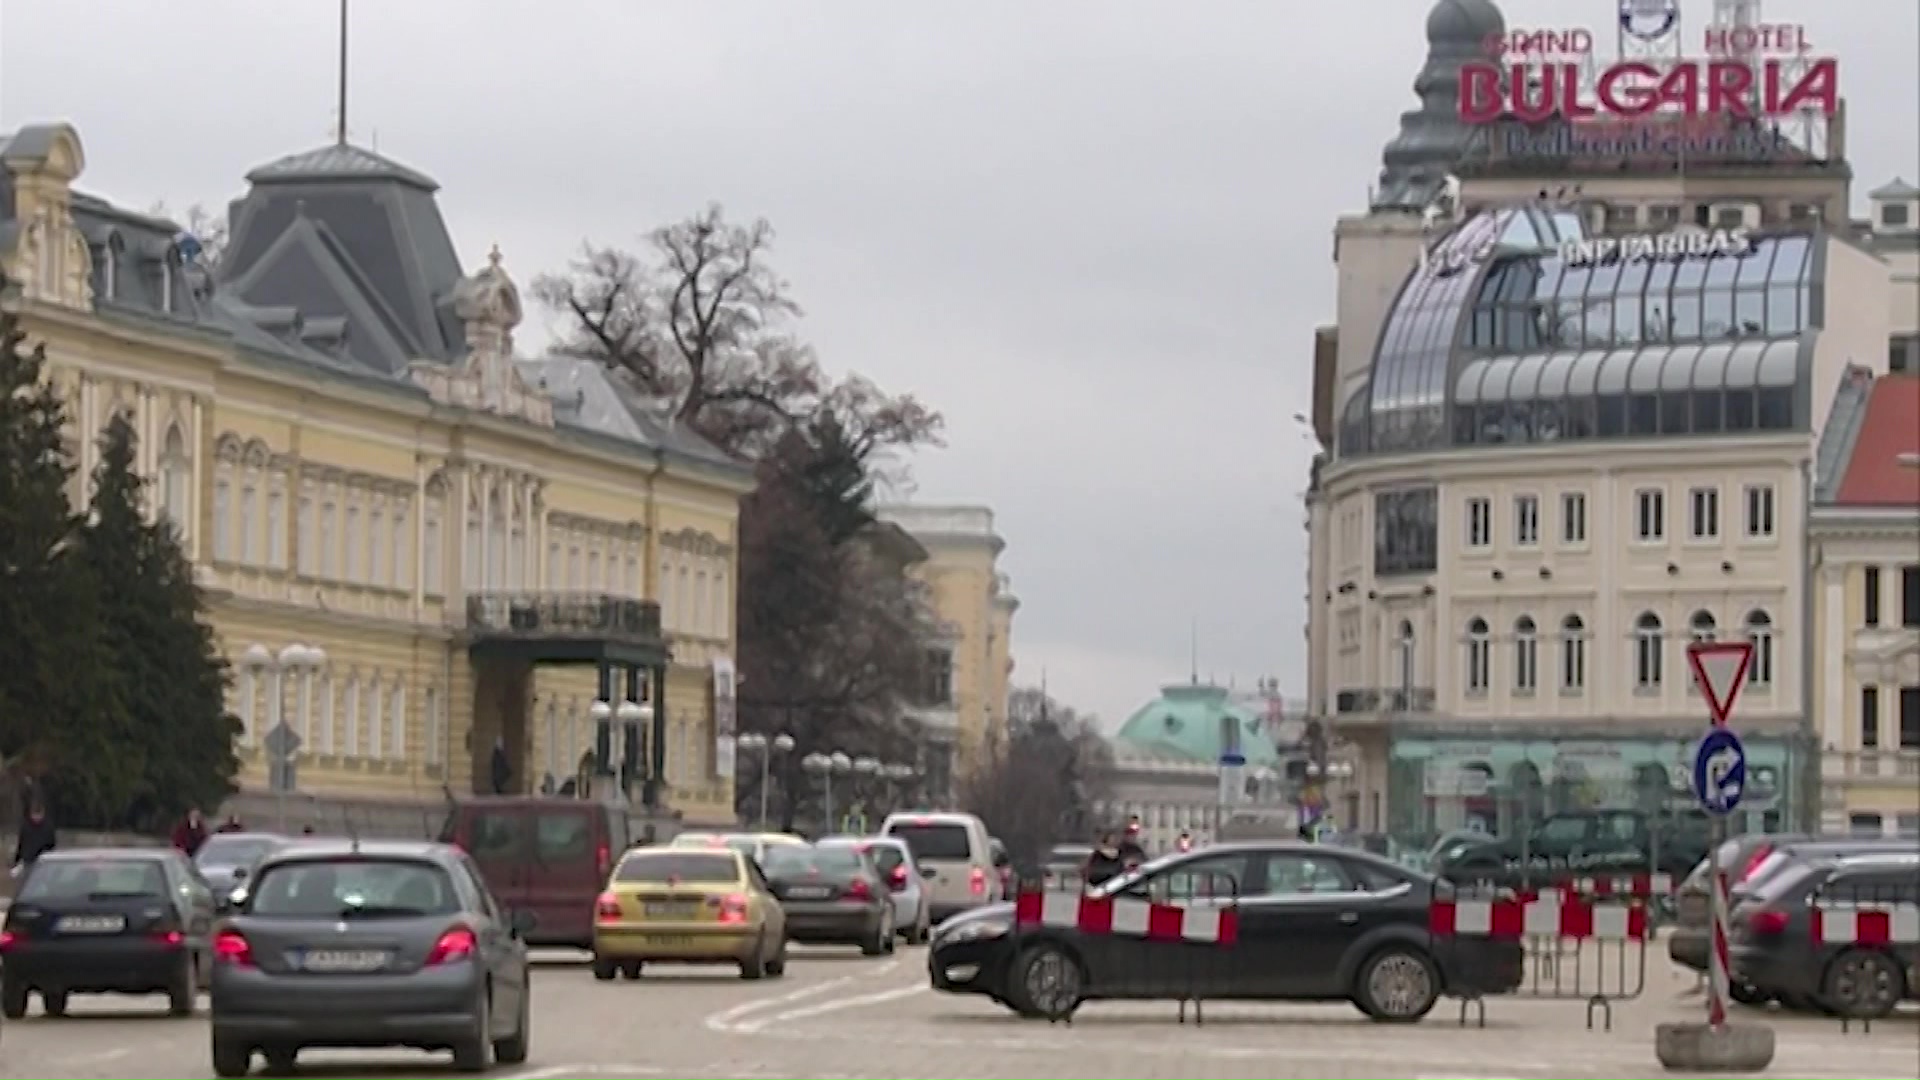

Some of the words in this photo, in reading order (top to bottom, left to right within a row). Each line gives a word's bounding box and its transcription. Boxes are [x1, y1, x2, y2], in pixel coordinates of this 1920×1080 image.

[1484, 28, 1593, 56] GRAND
[1704, 24, 1813, 54] HOTEL
[1459, 58, 1838, 124] BULGARIA
[1620, 227, 1750, 259] PARIBAS
